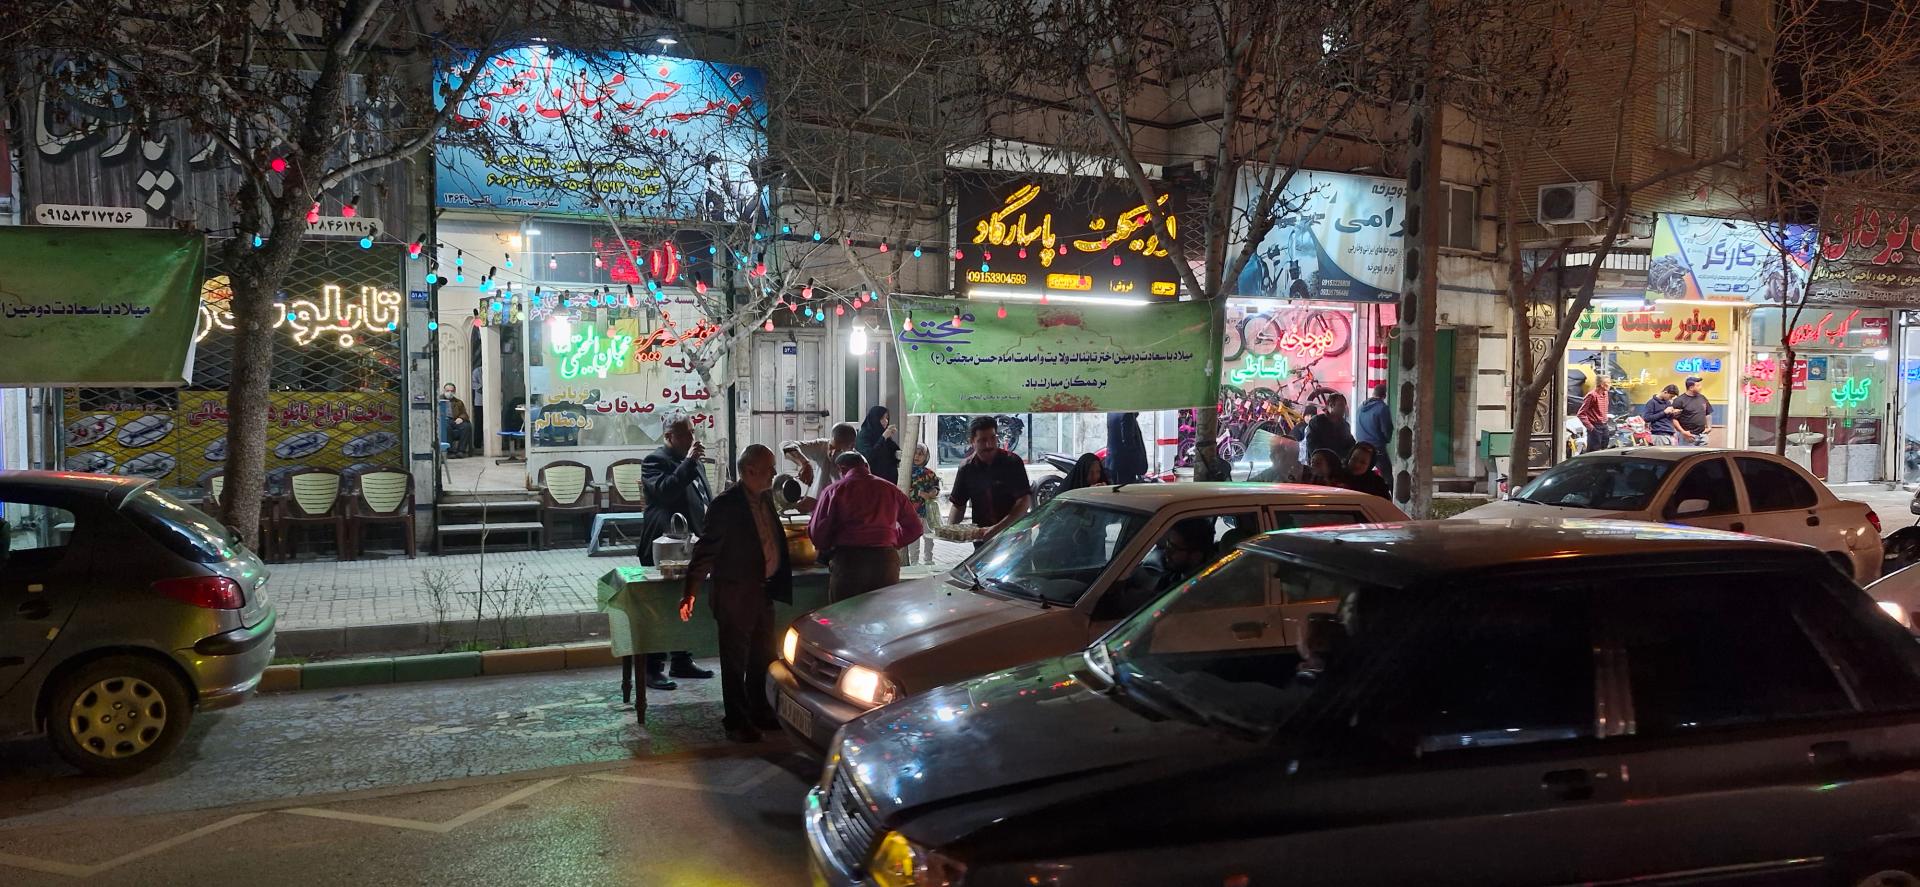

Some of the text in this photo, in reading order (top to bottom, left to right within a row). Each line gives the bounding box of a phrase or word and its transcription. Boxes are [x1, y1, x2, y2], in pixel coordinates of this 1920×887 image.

[40, 207, 134, 224] ۰۹۱۵۸۳۱۷۲۵۶
[972, 184, 1056, 267] پاسارگاد
[1702, 238, 1756, 271] کارگر
[967, 272, 1027, 285] 09153304593
[1279, 327, 1334, 358] دوچرخه
[945, 352, 974, 365] مجتبی
[973, 352, 998, 365] حسن
[1113, 352, 1139, 364] دومین
[1230, 353, 1289, 384] اقساطی
[1831, 377, 1872, 408] کباب
[596, 395, 655, 414] صدقات
